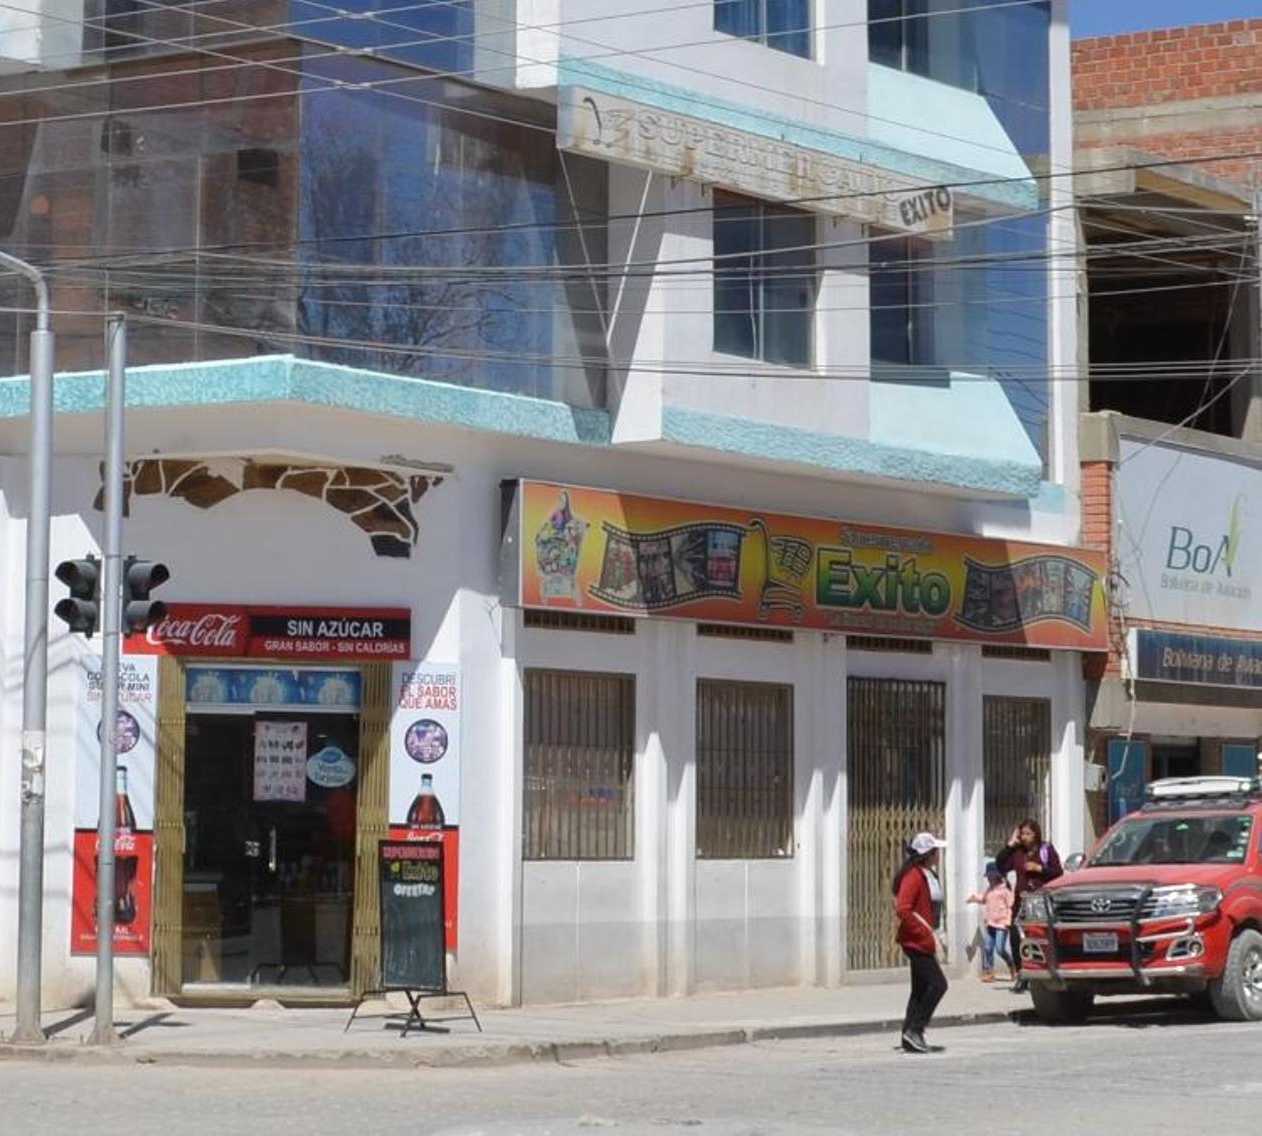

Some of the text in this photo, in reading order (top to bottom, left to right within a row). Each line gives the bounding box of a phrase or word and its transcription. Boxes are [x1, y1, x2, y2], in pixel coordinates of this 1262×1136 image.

[898, 185, 952, 227] EXITO
[1166, 524, 1234, 578] BoA
[817, 547, 952, 616] Exito
[286, 617, 384, 638] SIN AZÚCAR
[264, 640, 294, 651] GRAN
[295, 641, 330, 652] SABOR
[337, 642, 354, 652] SIN
[1161, 647, 1214, 671] Boliviana
[1217, 652, 1233, 673] de
